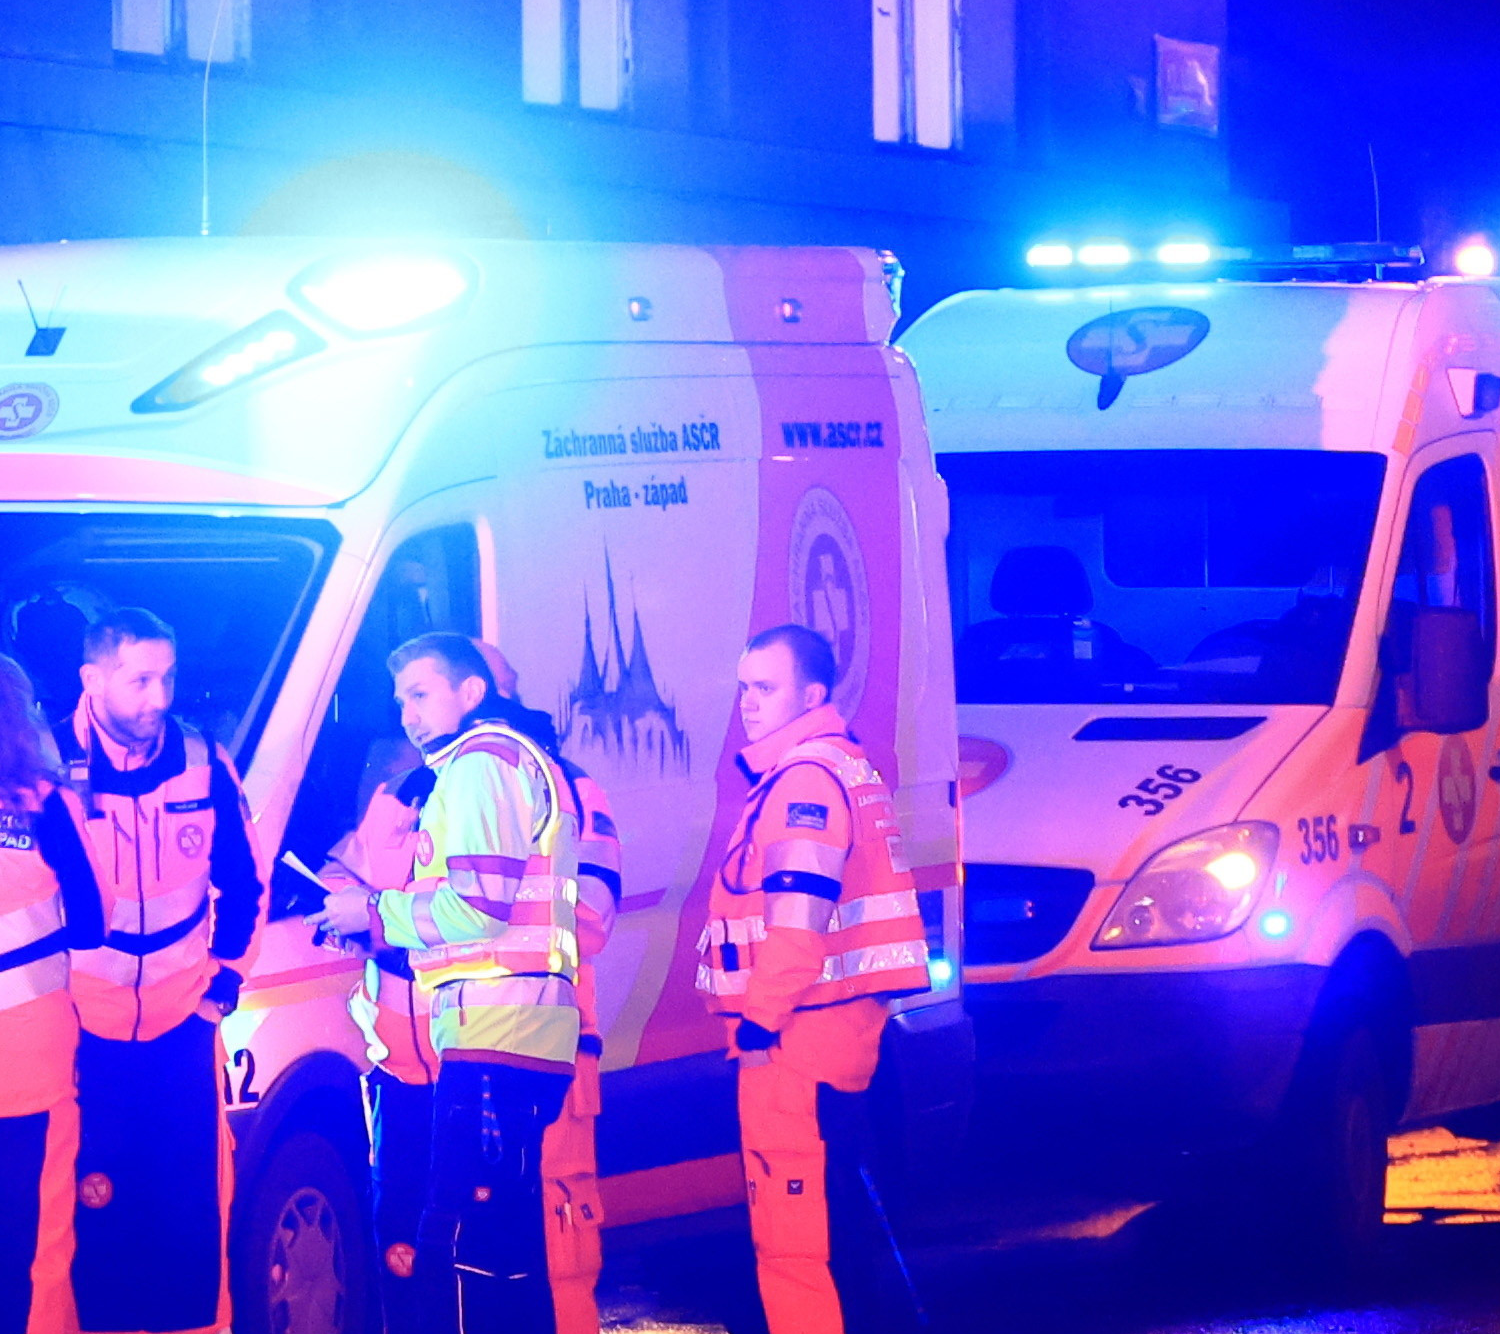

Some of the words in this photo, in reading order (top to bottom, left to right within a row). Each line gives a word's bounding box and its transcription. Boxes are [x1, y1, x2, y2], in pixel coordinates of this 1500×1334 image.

[541, 424, 627, 459] Záchranná
[629, 422, 679, 454] služba
[583, 478, 632, 510] Praha
[642, 474, 689, 511] západ
[1117, 763, 1202, 817] 356
[1298, 814, 1340, 865] 356
